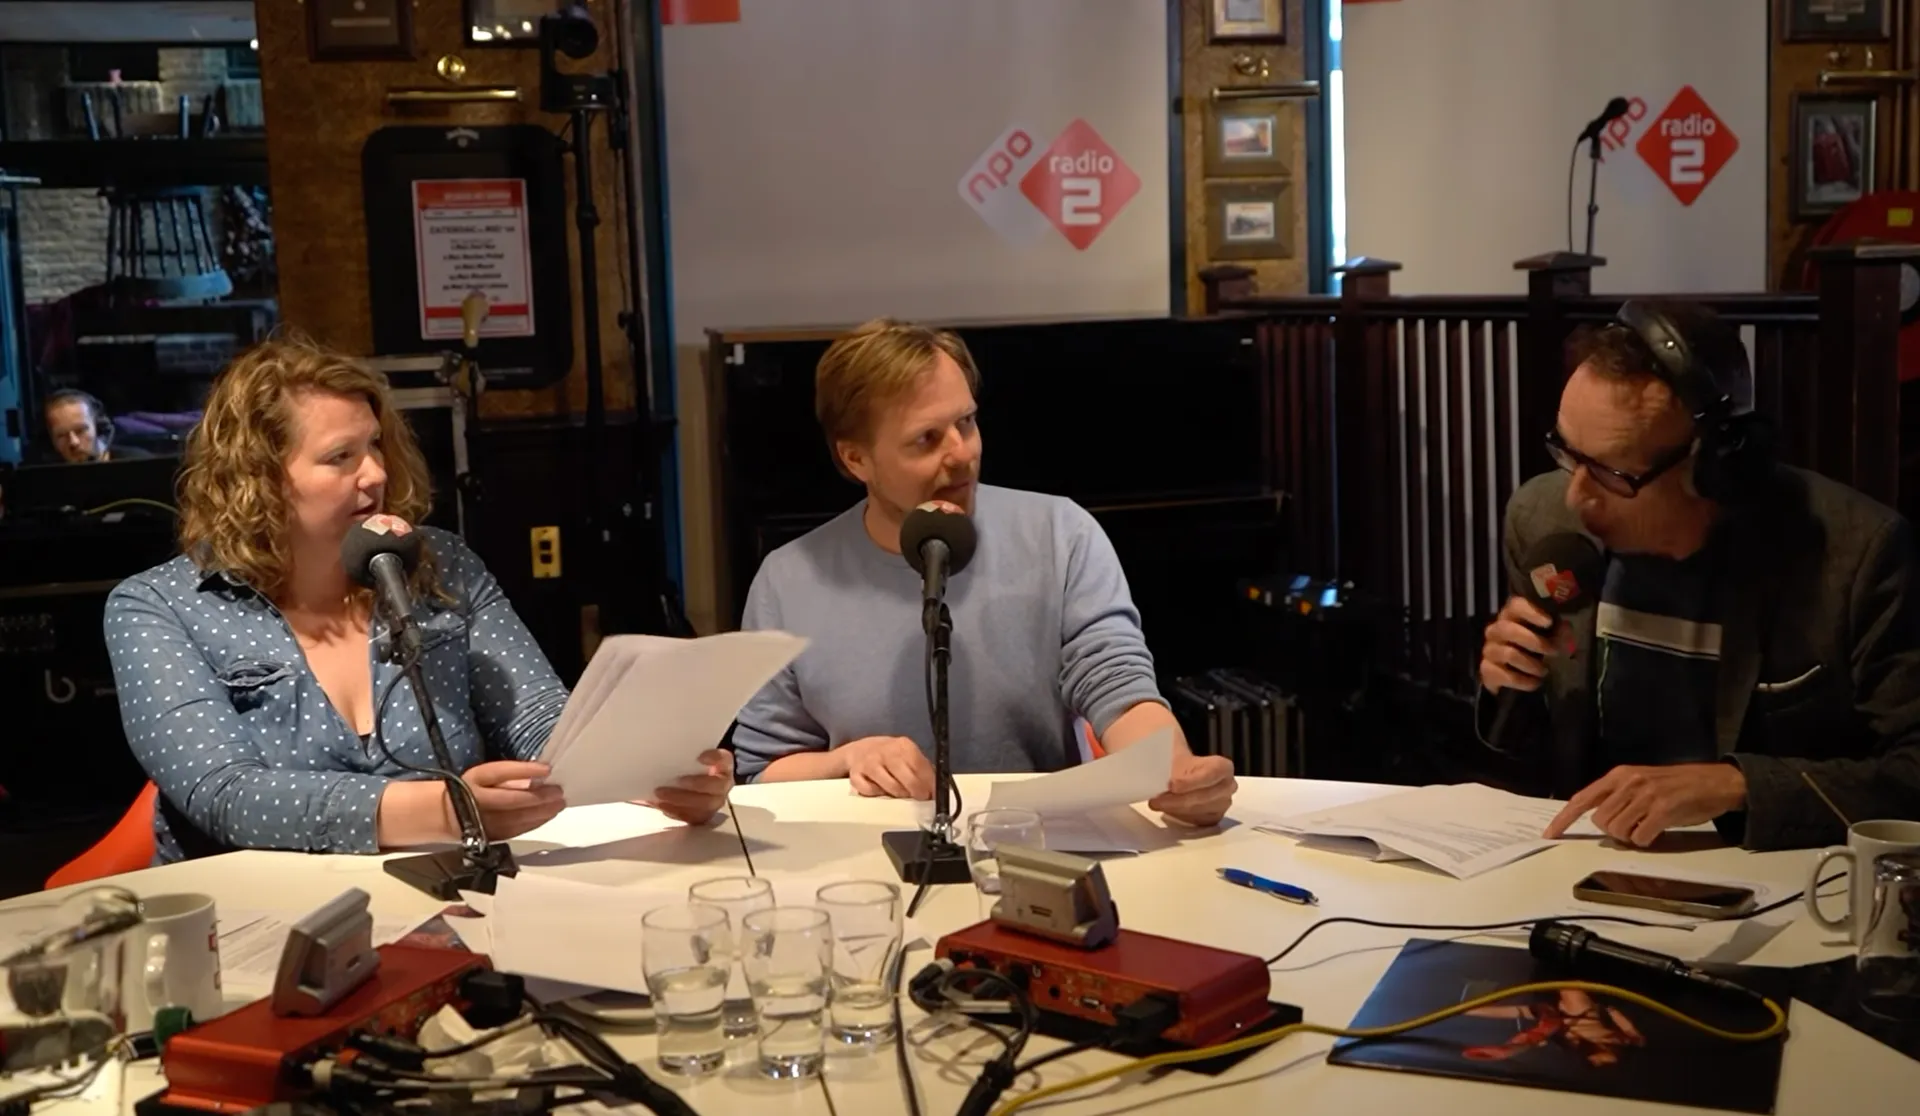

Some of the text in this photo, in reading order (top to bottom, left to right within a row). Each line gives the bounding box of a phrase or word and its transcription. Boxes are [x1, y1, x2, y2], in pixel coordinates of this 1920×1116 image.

[1661, 115, 1716, 136] radio
[967, 129, 1033, 204] npo
[1050, 150, 1114, 173] radio
[1670, 139, 1705, 184] 2
[1062, 178, 1101, 225] 2
